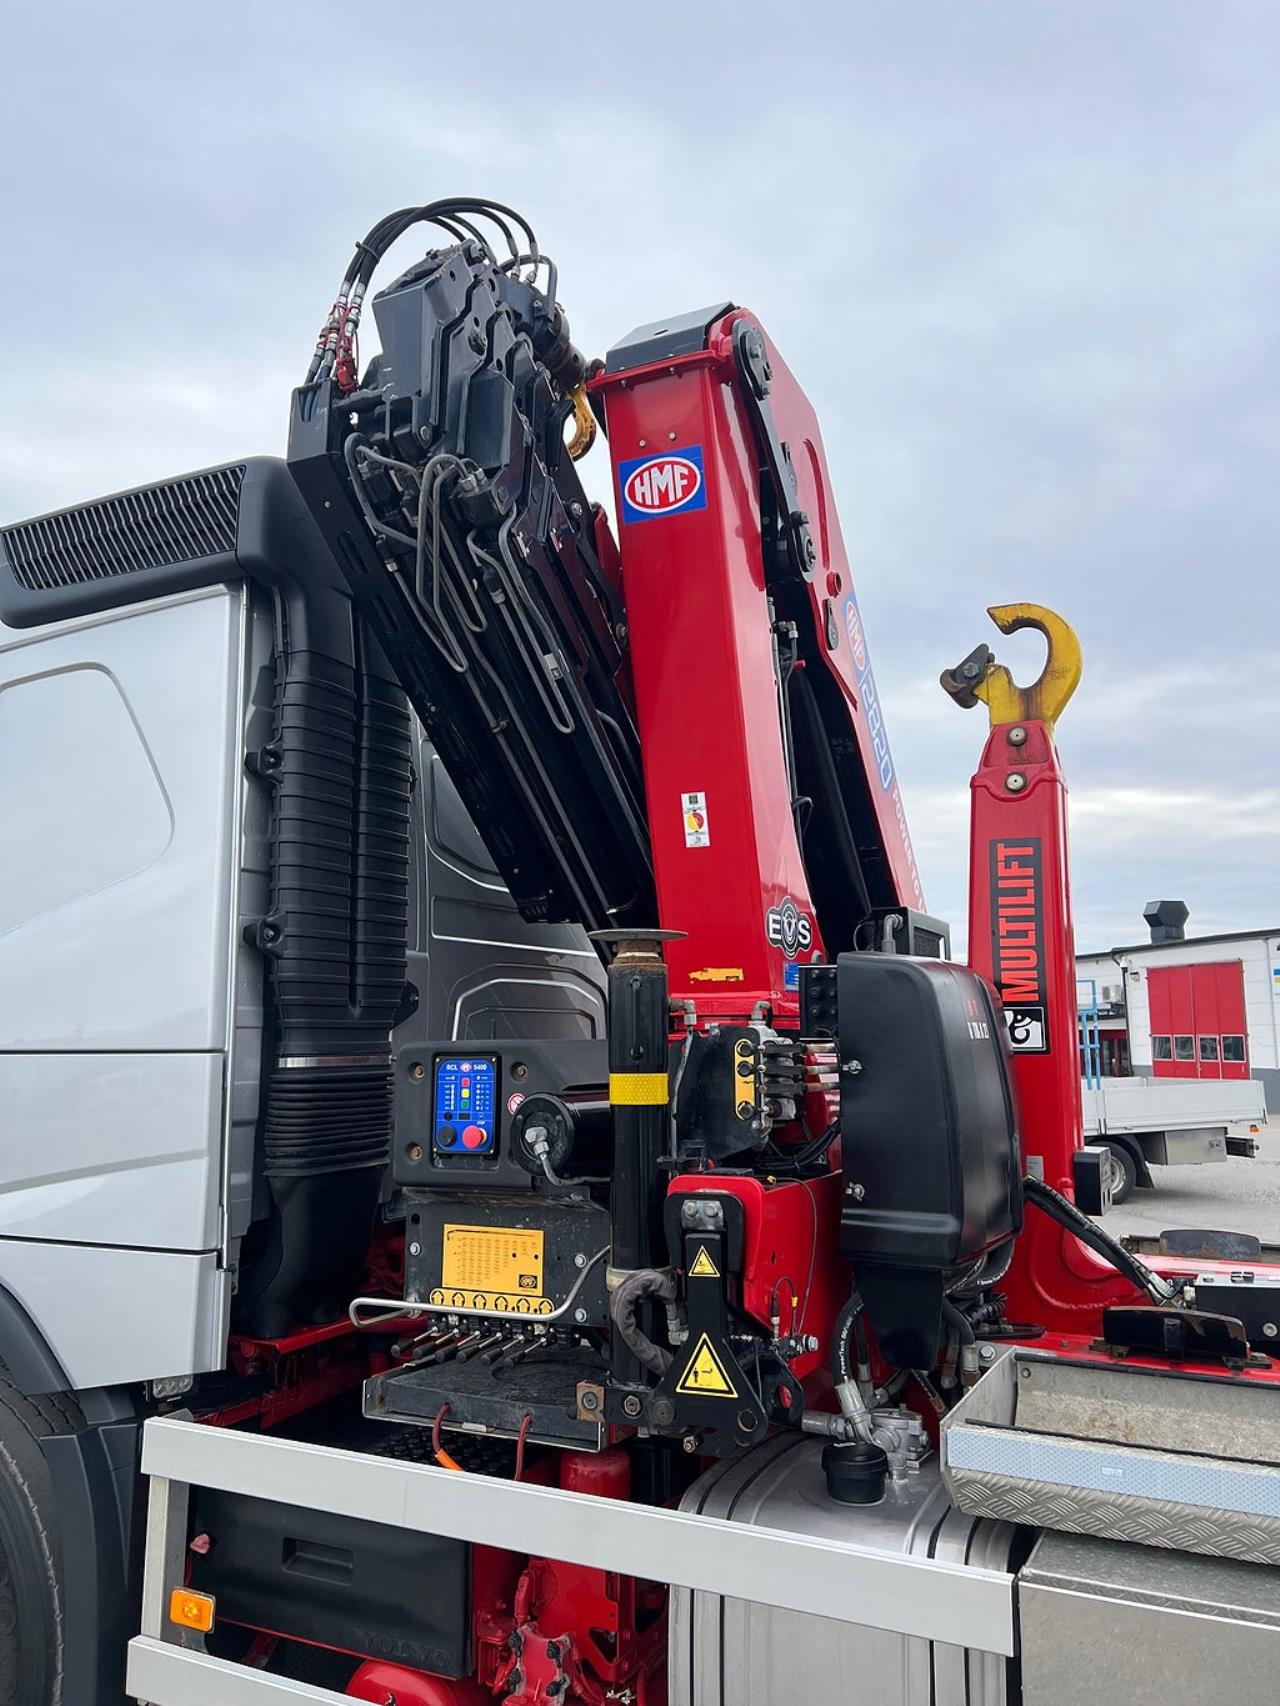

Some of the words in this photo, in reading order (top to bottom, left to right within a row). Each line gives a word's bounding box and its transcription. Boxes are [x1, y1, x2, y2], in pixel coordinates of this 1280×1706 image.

[634, 464, 689, 506] HMF
[862, 674, 893, 790] 2820
[996, 843, 1040, 1002] MULTILIFT
[353, 1627, 453, 1669] VOLVO
